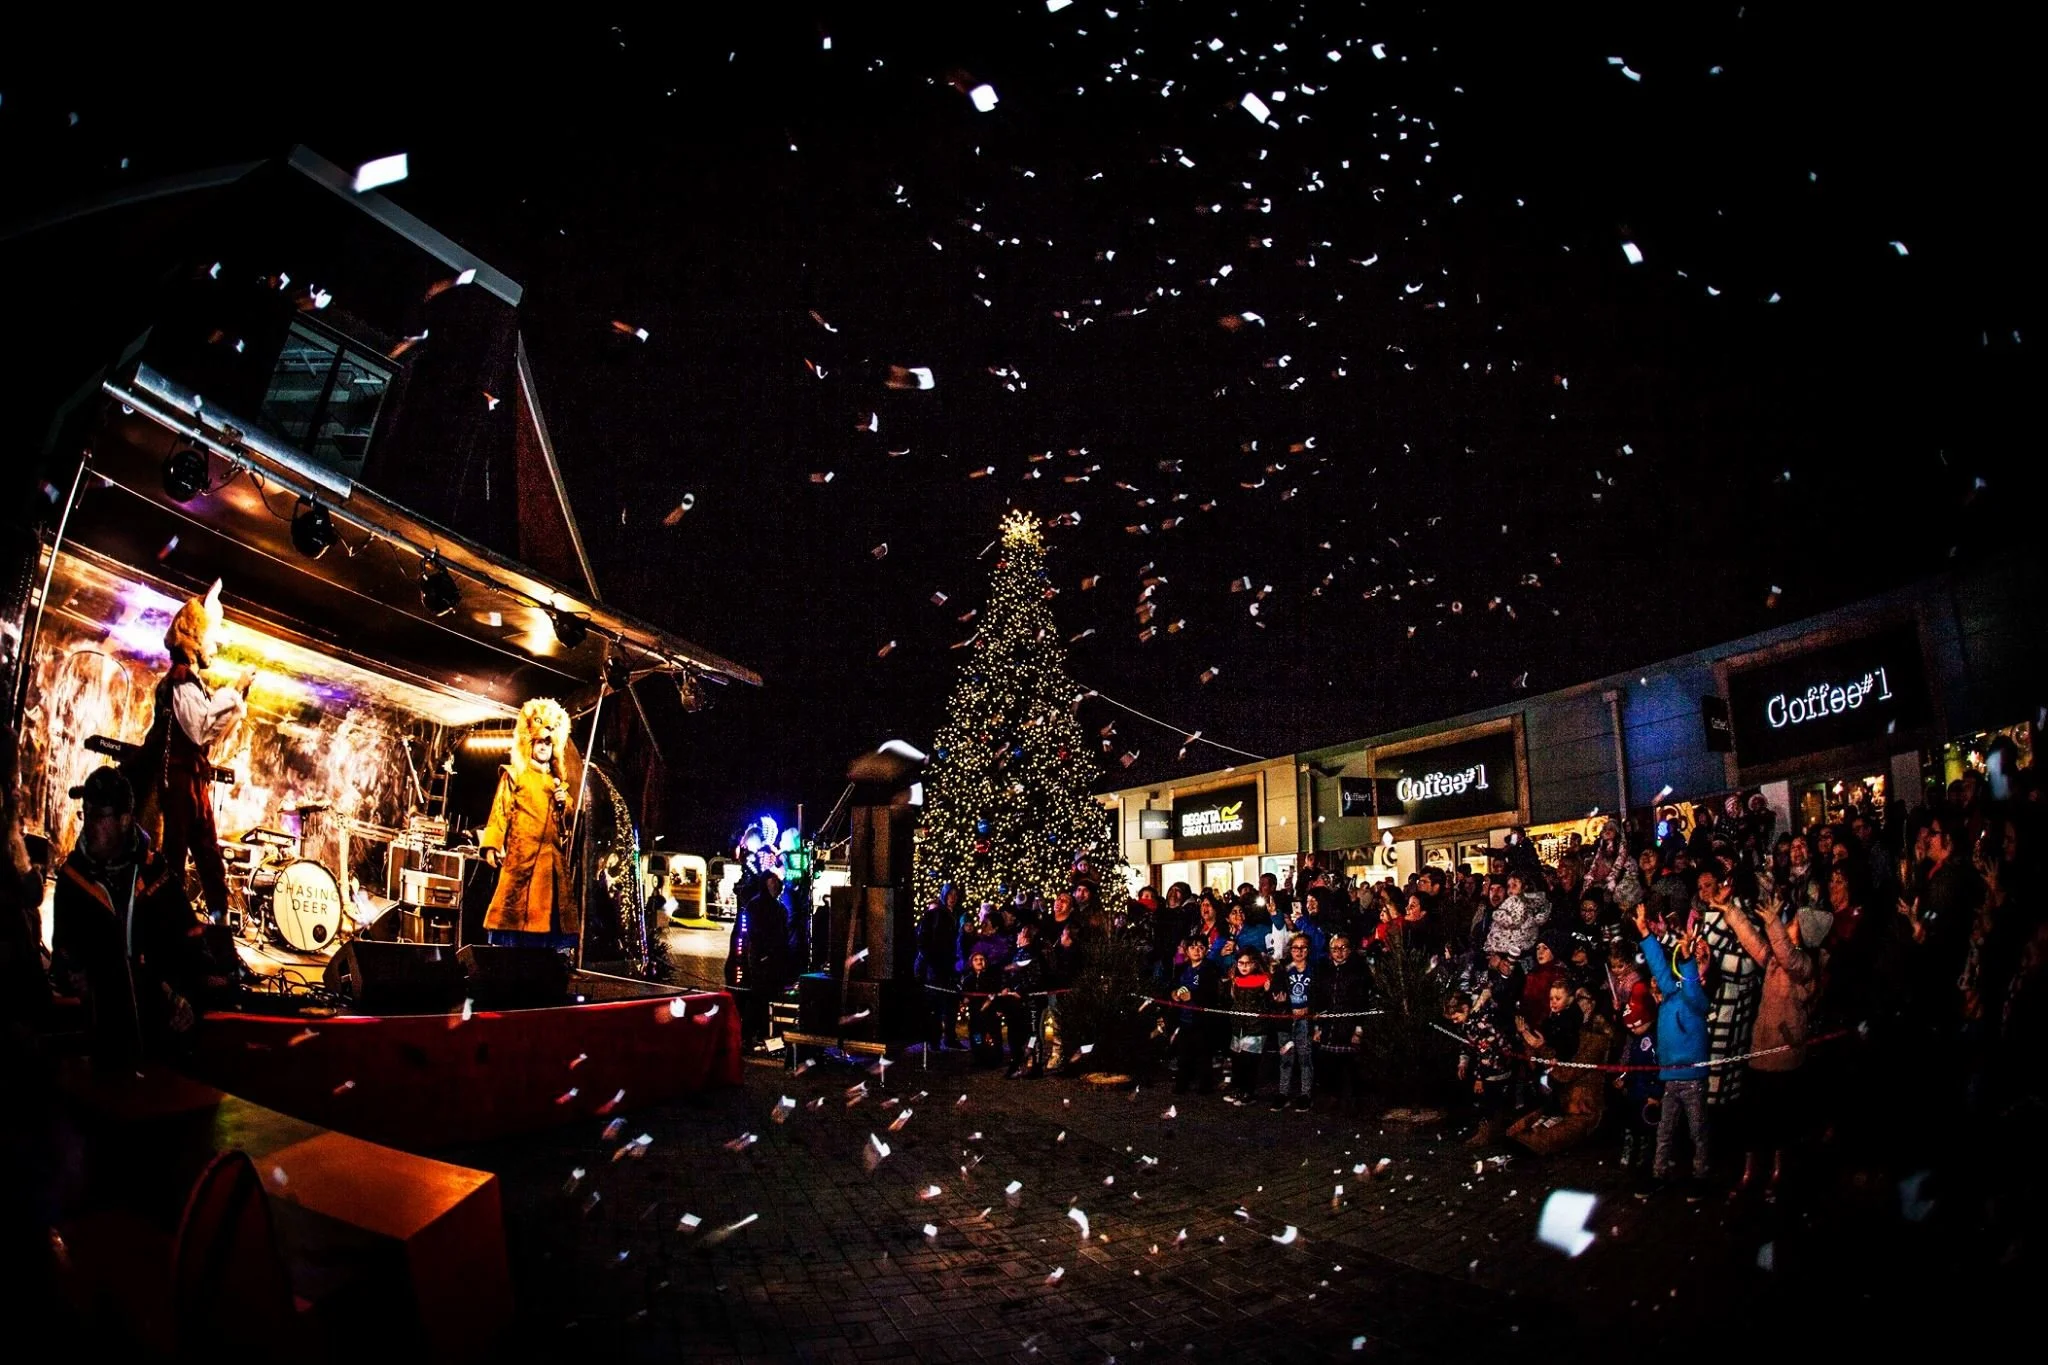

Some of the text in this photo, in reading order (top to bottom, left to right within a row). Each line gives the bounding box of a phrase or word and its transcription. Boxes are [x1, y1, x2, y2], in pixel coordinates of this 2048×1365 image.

[1768, 666, 1892, 727] Coffee#1
[99, 739, 122, 751] Roland
[1396, 764, 1490, 802] Coffee#1
[1182, 809, 1221, 826] REGATTA
[1182, 824, 1204, 837] GREAT
[1204, 819, 1243, 834] OUTDOORS
[274, 881, 340, 903] CHASING
[291, 898, 328, 916] DEER
